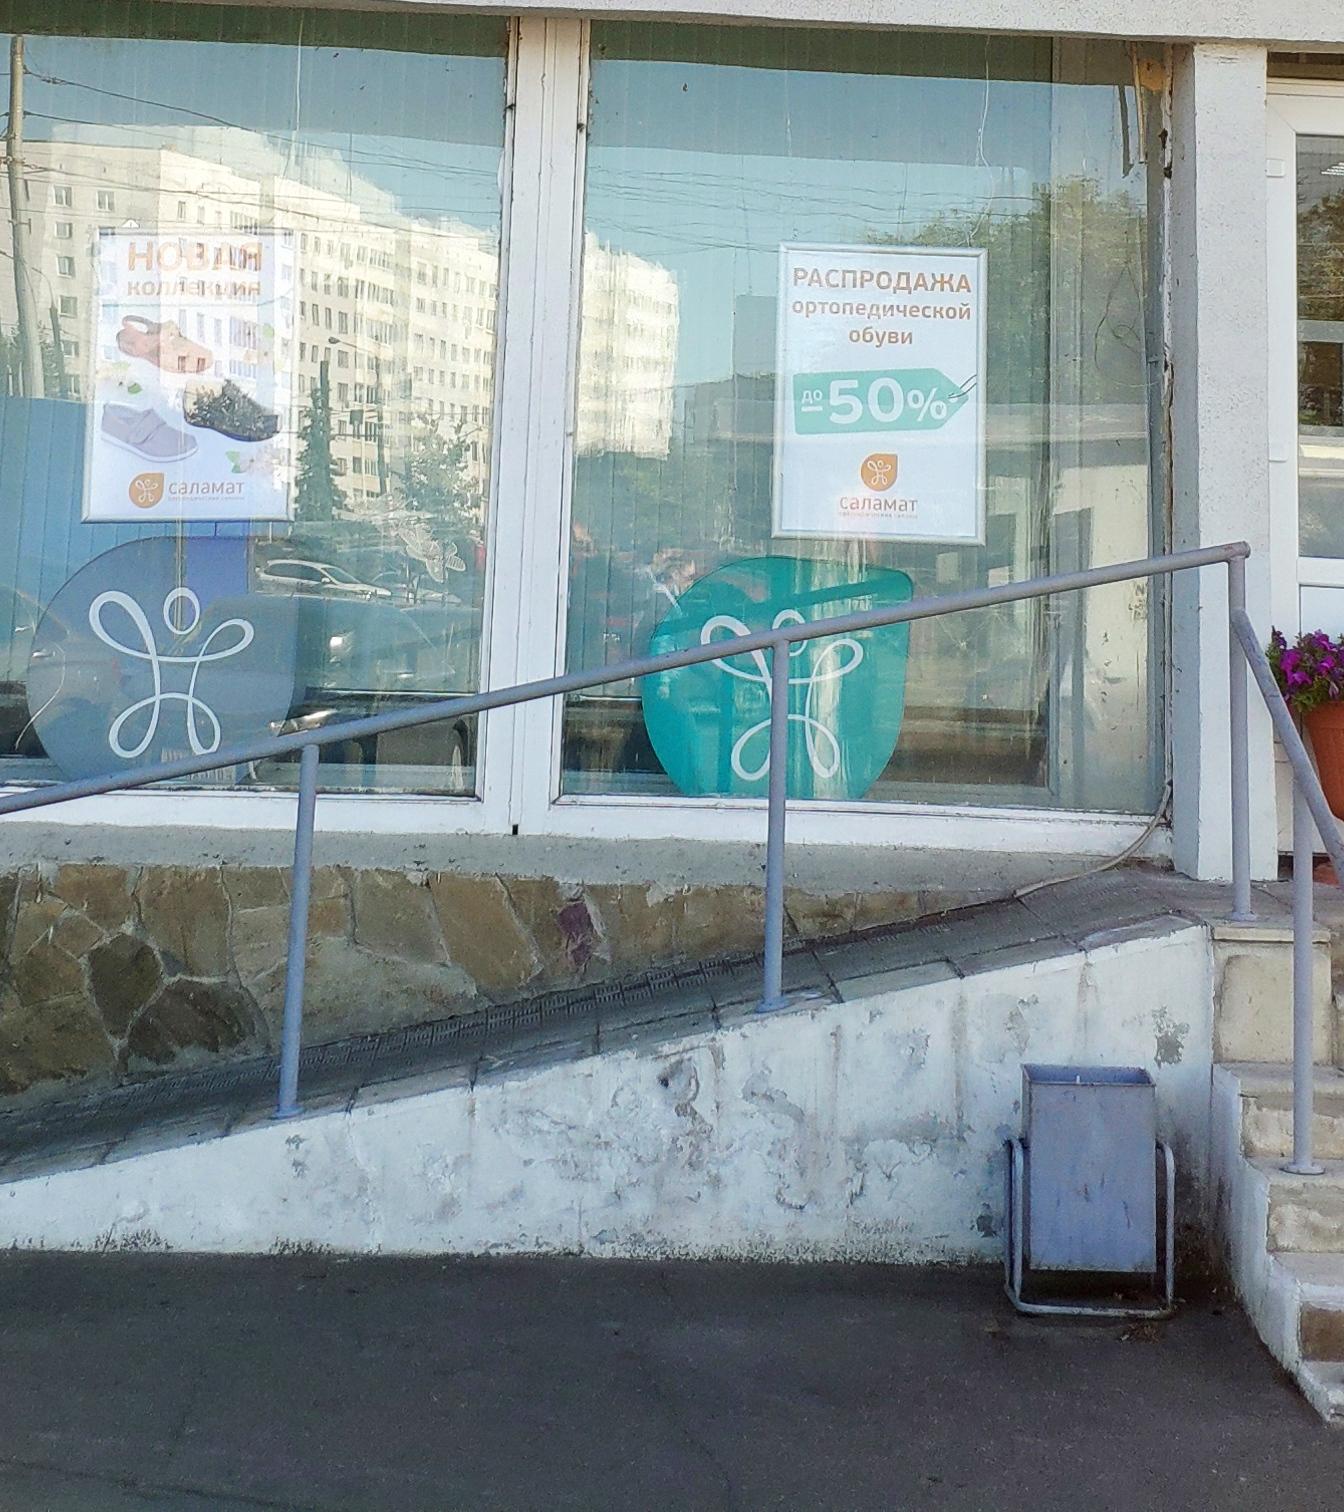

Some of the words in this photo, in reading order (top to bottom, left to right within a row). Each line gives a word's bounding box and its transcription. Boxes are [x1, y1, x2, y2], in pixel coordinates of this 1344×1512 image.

[128, 241, 263, 271] НОВАЯ
[793, 267, 972, 294] РАСПРОДАЖА
[792, 300, 971, 320] ортопедической
[849, 326, 913, 348] обуви
[169, 481, 245, 495] саламат
[839, 496, 918, 512] саламат
